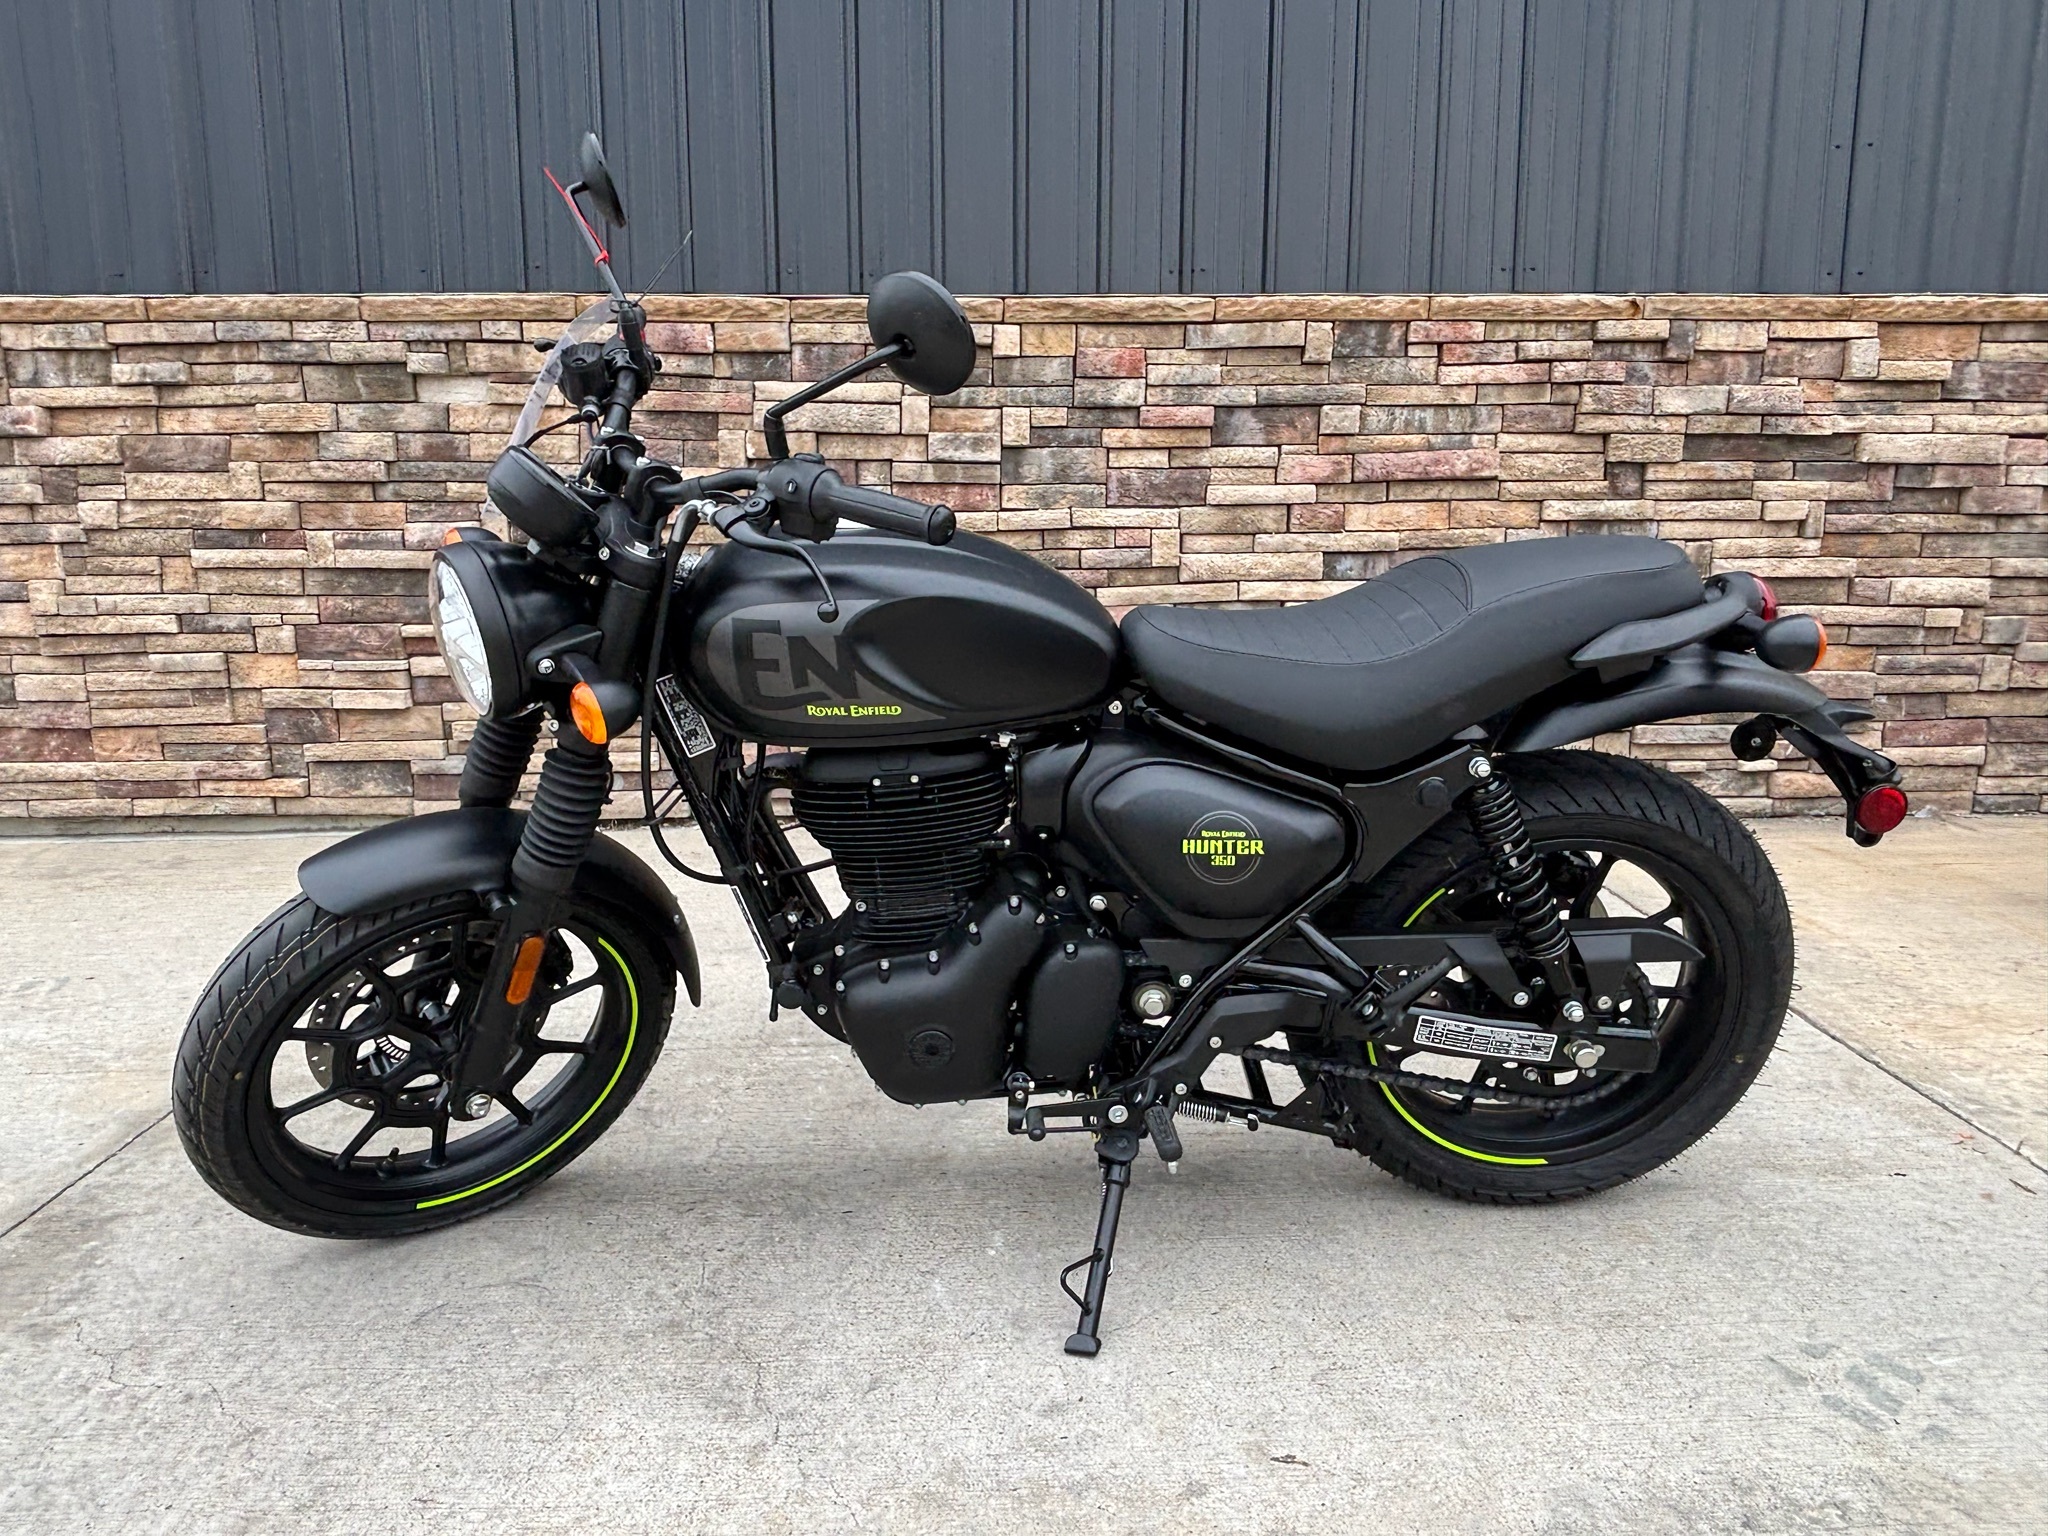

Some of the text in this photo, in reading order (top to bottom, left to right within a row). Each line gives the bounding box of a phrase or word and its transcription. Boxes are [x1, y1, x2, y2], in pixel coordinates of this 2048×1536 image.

[806, 704, 902, 718] ROYAL ENFIELD
[1182, 839, 1265, 855] HUNTER
[1210, 855, 1236, 866] 350
